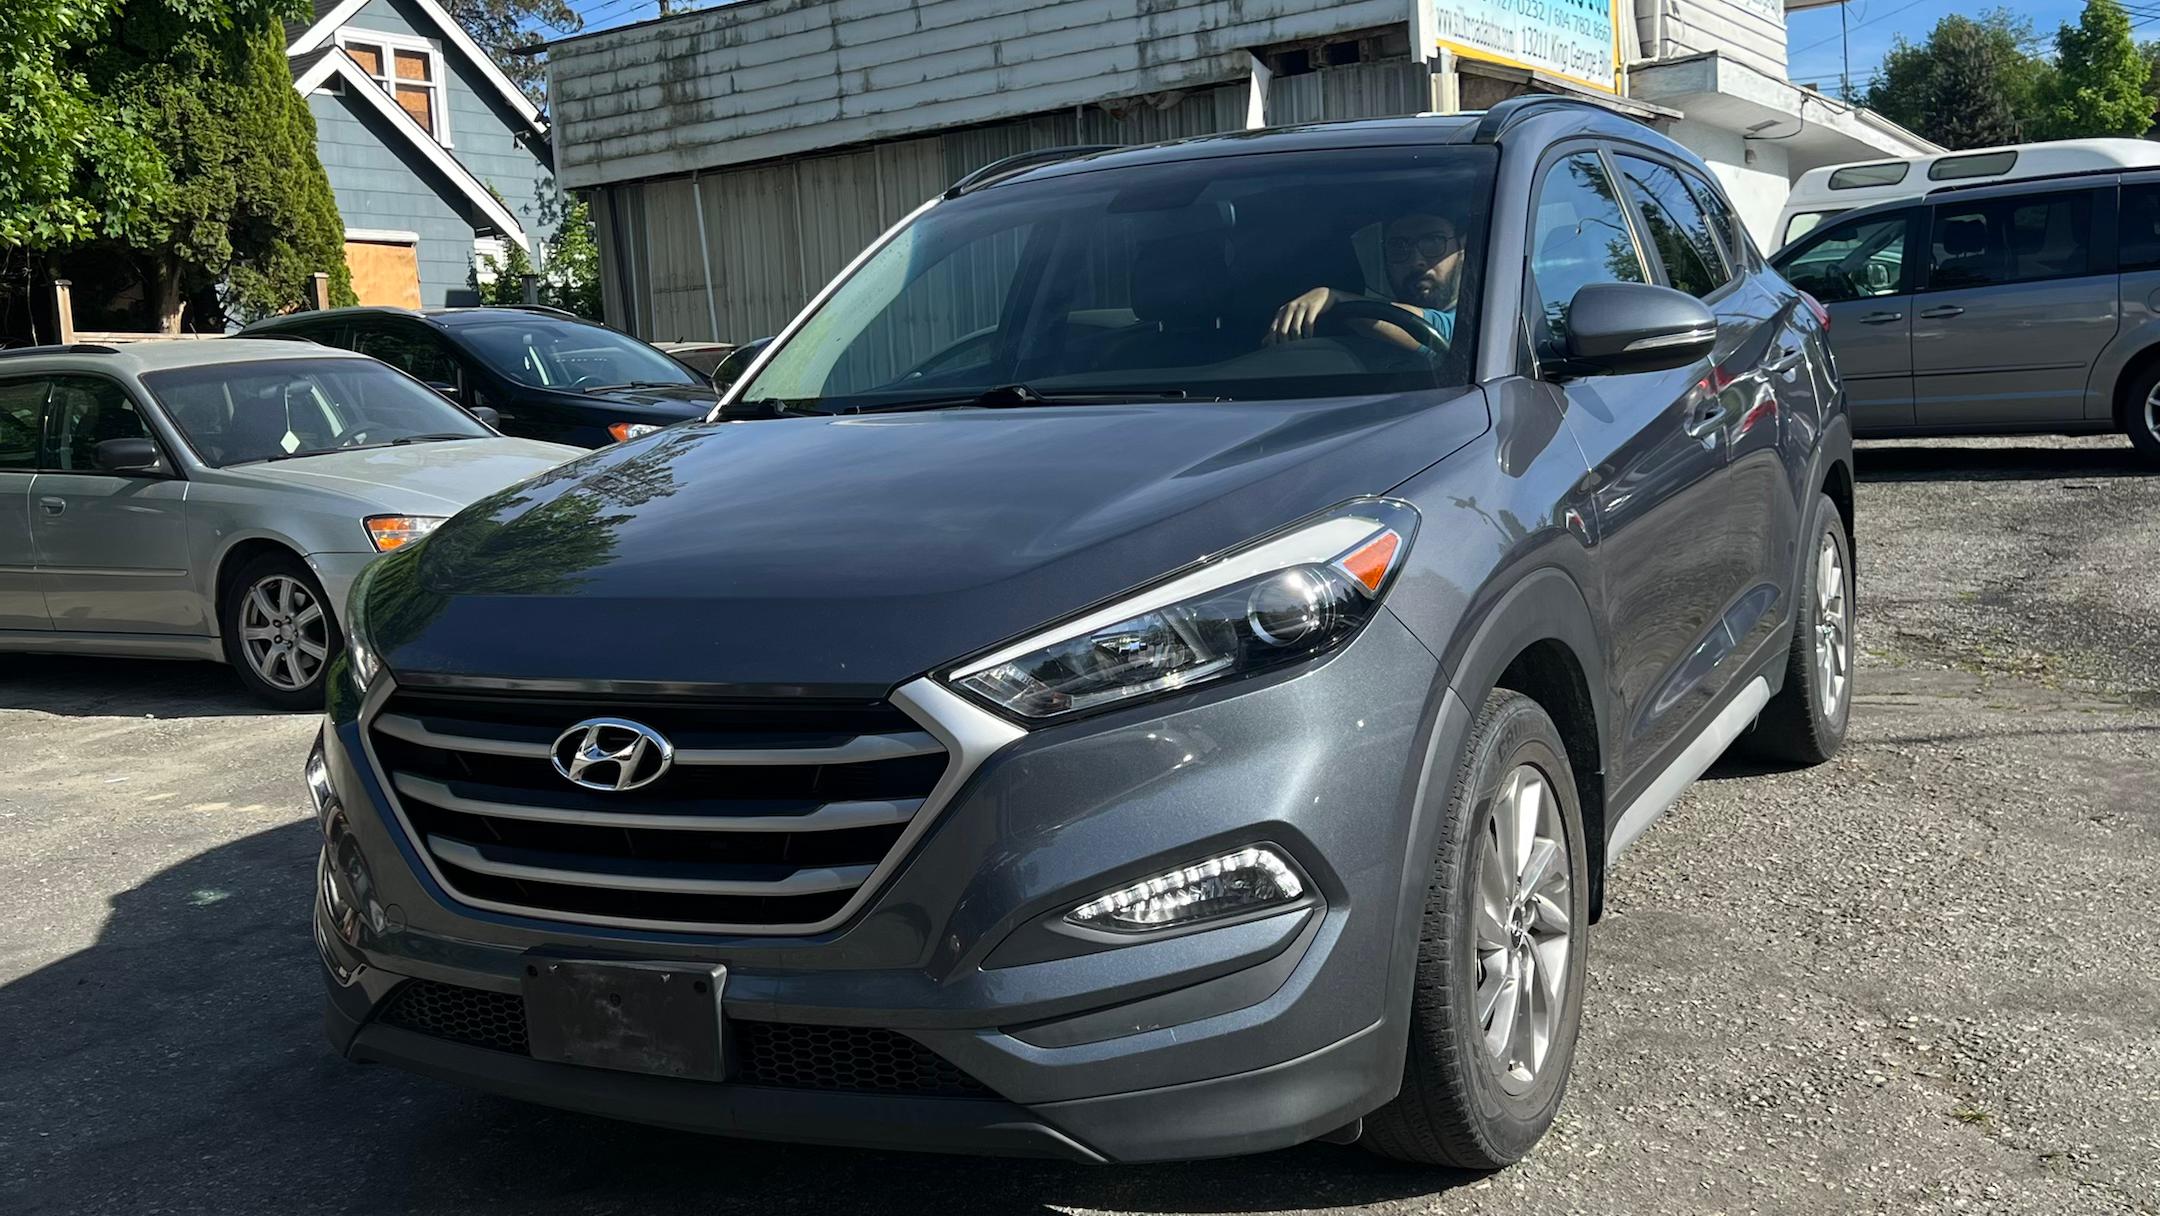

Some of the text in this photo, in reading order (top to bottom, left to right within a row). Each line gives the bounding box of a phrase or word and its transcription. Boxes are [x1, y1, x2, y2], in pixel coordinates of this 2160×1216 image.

[1517, 0, 1545, 20] 0232
[1554, 7, 1570, 31] 604
[1572, 14, 1591, 37] 782
[1522, 26, 1547, 60] 13211
[1550, 33, 1568, 73] King
[1570, 40, 1597, 80] George
